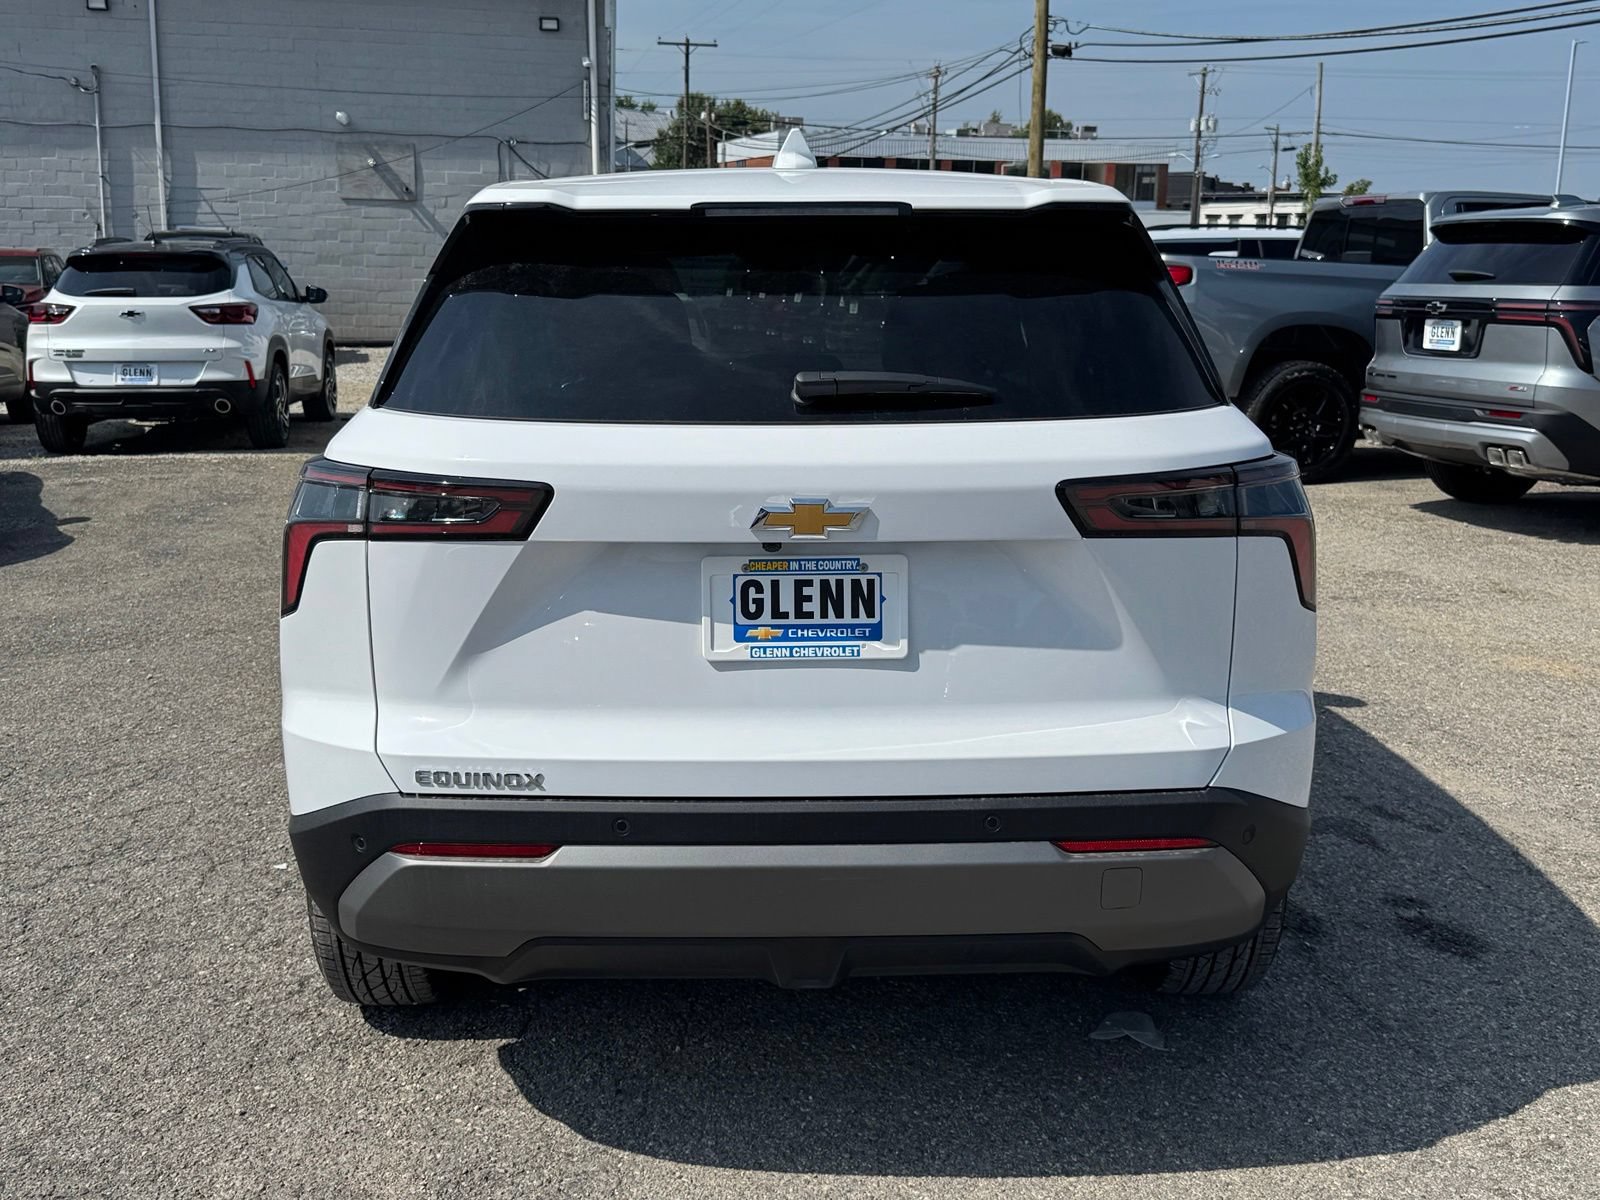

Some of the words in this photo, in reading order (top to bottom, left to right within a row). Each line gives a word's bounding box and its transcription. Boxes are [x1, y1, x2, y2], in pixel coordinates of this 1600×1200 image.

[1431, 326, 1456, 339] GLENN
[122, 367, 152, 378] GLENN
[749, 560, 788, 572] CHEAPER
[789, 560, 799, 571] IN
[800, 560, 817, 571] THE
[818, 560, 860, 571] COUNTRY.
[739, 578, 876, 621] GLENN
[788, 627, 872, 638] CHEVROLET
[752, 647, 790, 658] GLENN
[792, 646, 860, 658] CHEVROLET
[415, 770, 546, 791] EQUINOX
